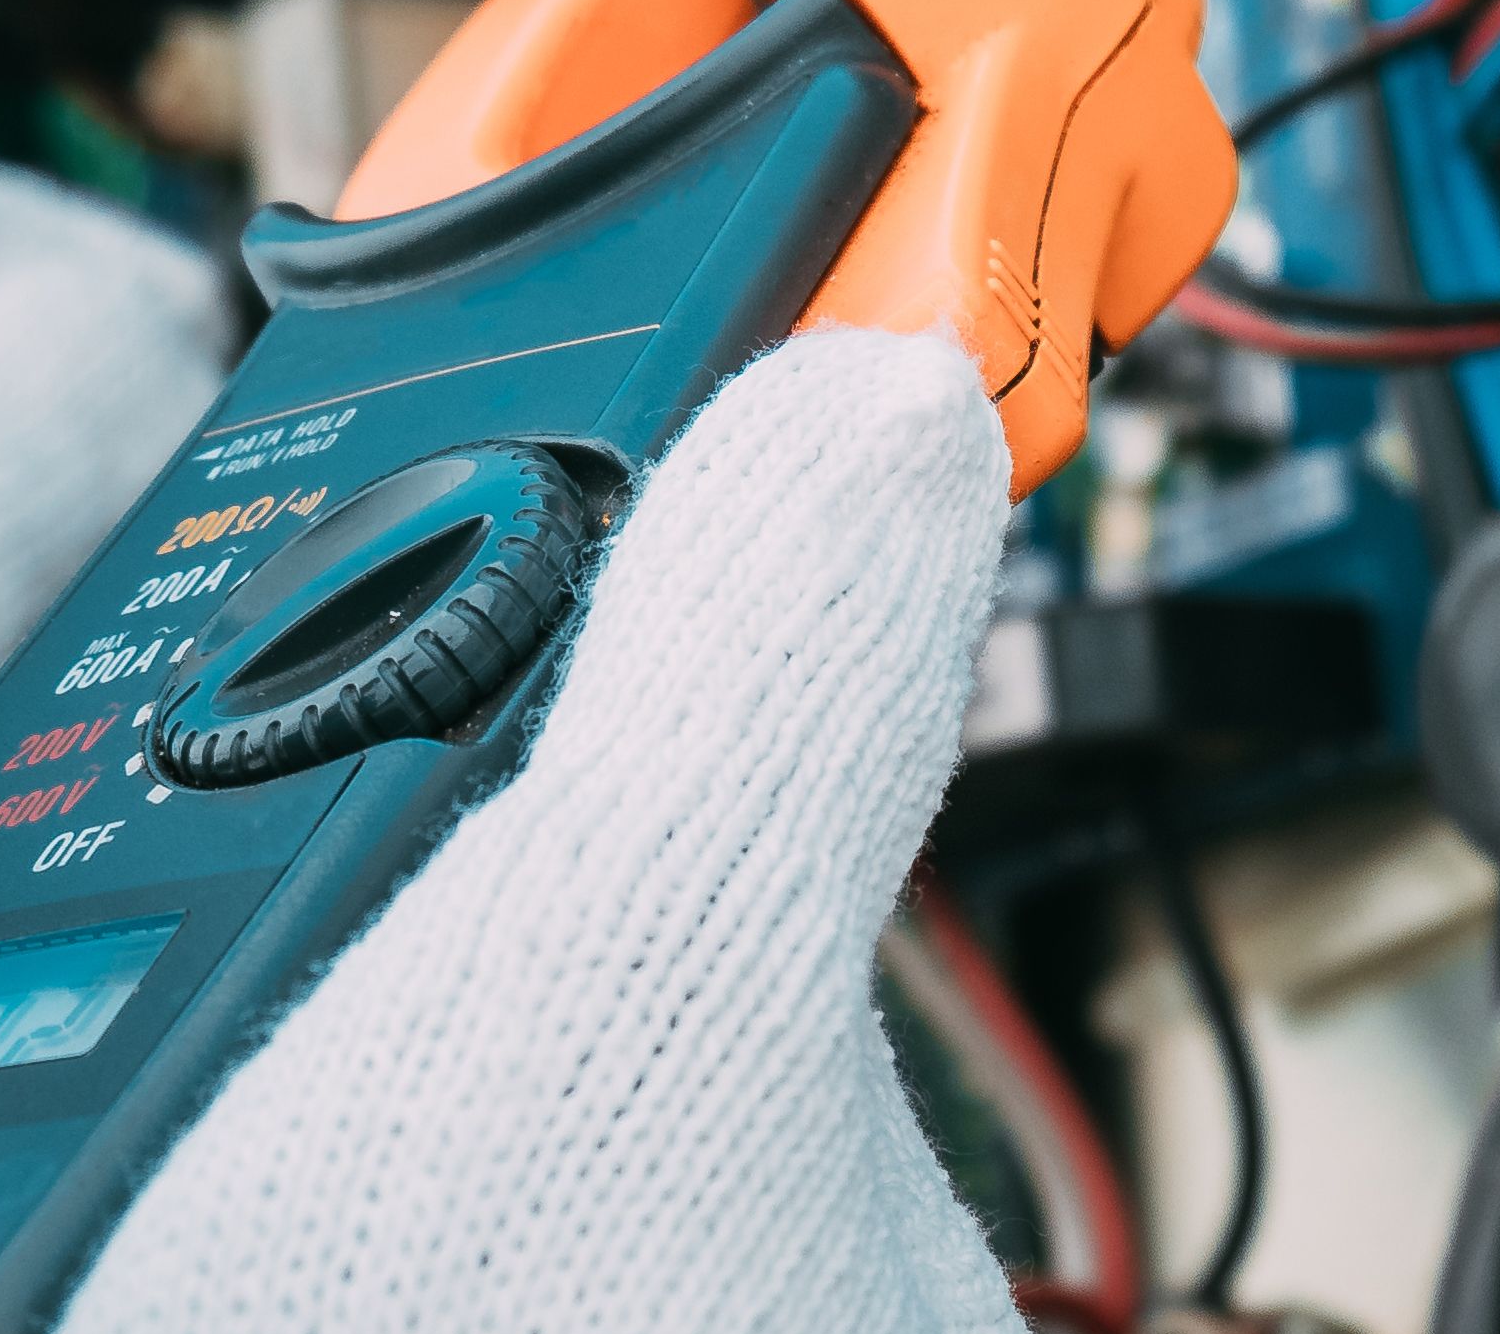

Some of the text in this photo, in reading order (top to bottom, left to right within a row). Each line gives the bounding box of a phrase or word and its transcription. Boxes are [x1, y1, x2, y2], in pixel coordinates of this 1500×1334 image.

[222, 408, 358, 460] DATA HOLD
[282, 433, 340, 462] HOLD
[82, 631, 131, 657] MAX
[3, 714, 119, 771] 200V
[32, 819, 127, 873] OFF
